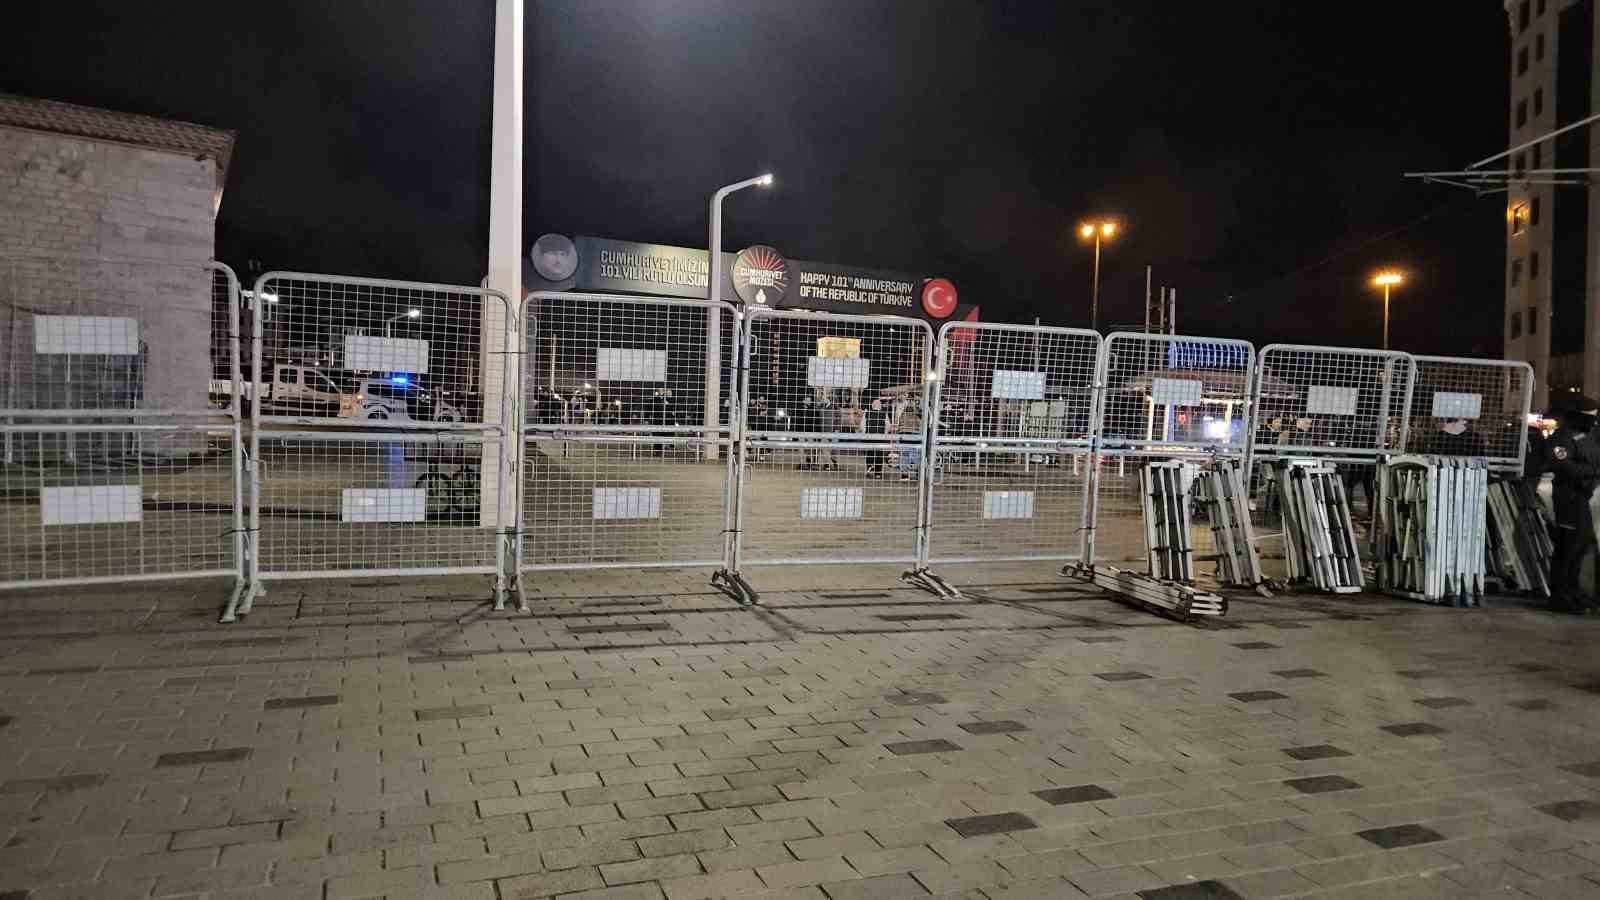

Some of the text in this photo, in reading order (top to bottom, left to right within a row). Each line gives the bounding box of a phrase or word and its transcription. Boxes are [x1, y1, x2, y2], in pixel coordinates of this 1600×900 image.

[643, 269, 674, 284] KUTLU
[677, 271, 709, 287] OLSUN
[800, 271, 830, 286] HAPPY
[853, 277, 914, 294] ANNIVERSARY
[800, 285, 811, 297] OF
[811, 286, 828, 299] THE
[828, 288, 867, 303] REPUBLIC
[868, 291, 879, 304] OF
